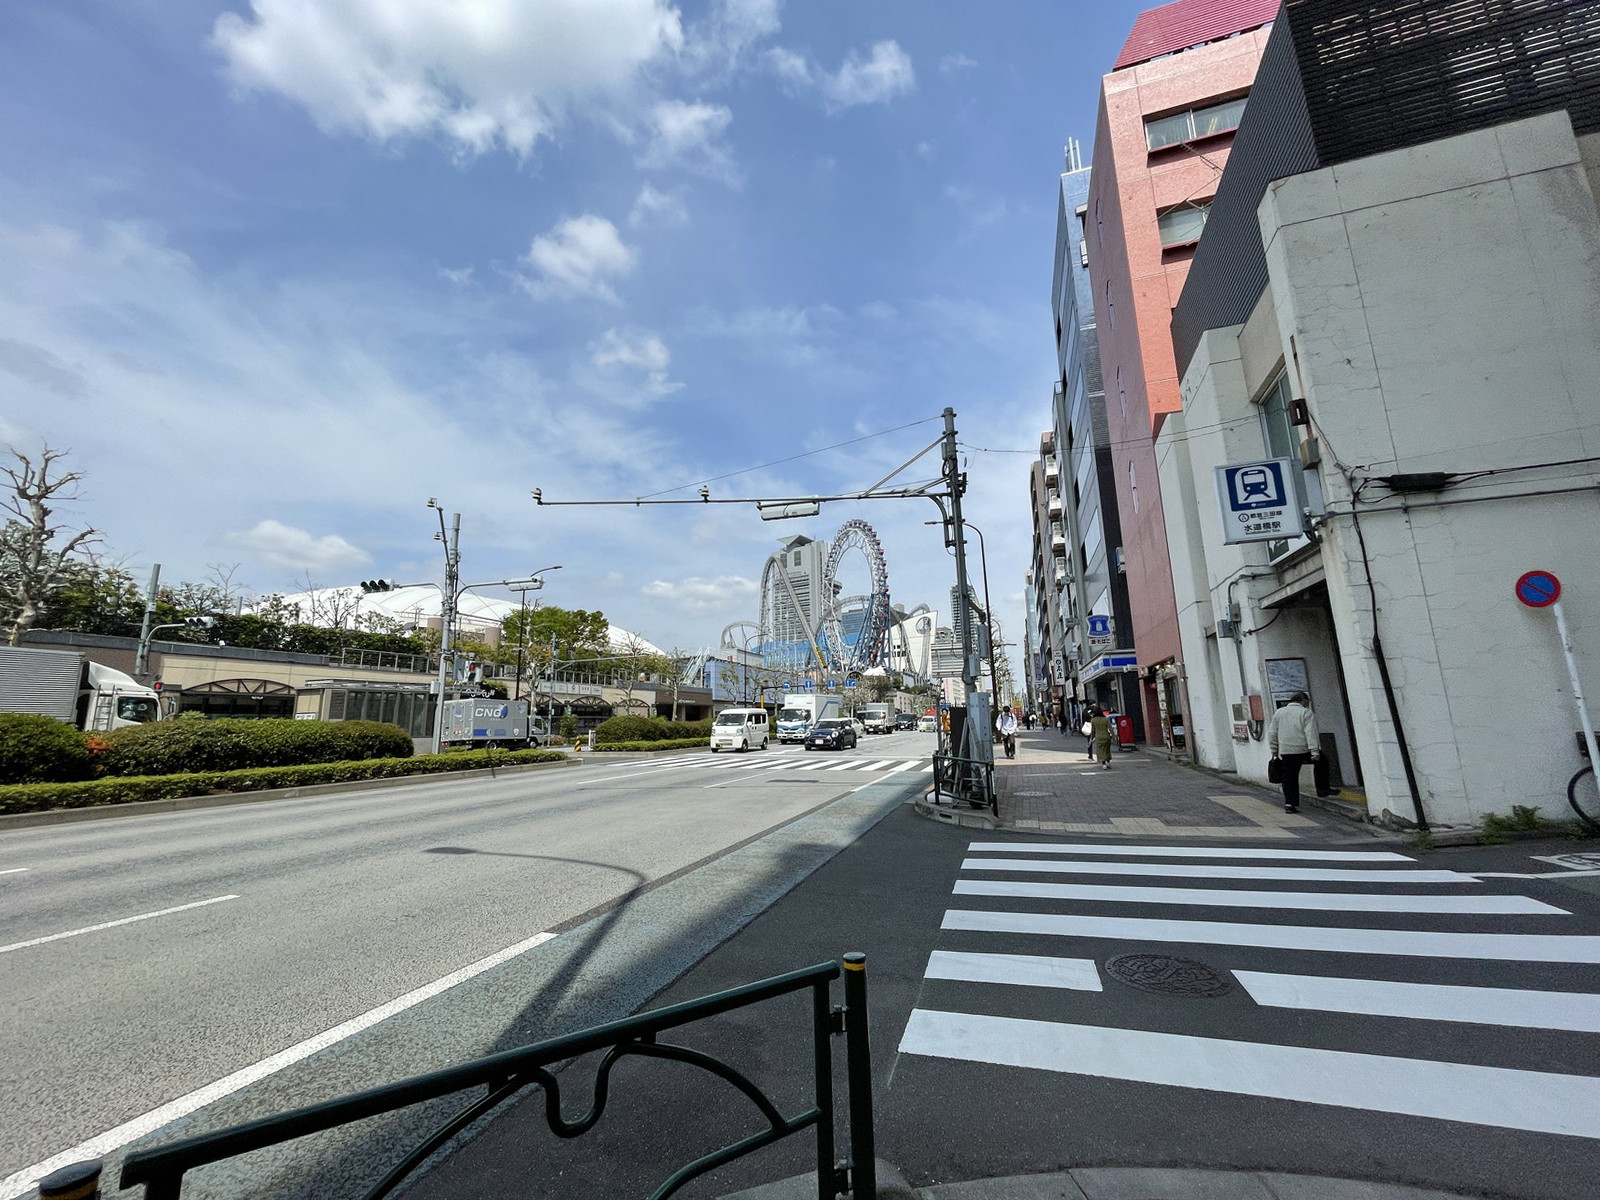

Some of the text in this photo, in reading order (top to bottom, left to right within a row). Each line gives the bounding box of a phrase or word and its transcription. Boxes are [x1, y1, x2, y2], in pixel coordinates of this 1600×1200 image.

[1244, 521, 1281, 532] 水道橋駅
[475, 708, 502, 718] CNG
